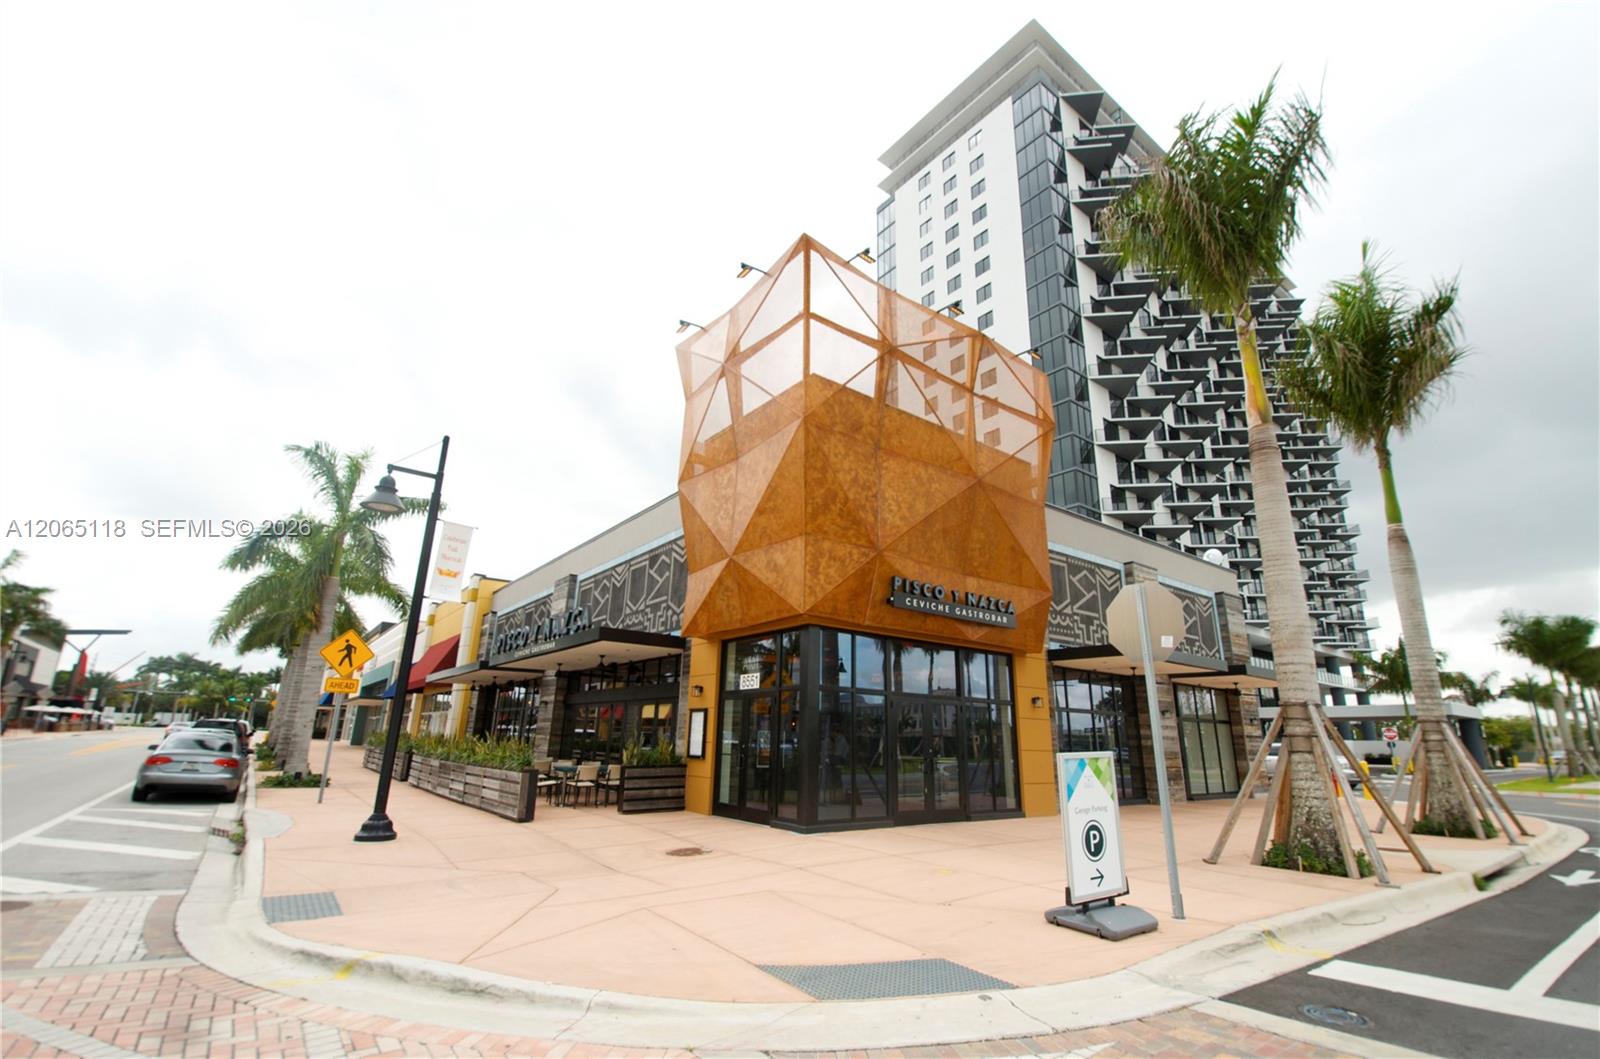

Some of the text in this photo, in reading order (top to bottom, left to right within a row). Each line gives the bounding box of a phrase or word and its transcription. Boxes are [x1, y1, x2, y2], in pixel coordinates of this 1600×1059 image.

[892, 576, 1016, 615] PISCO Y NAZCA
[905, 597, 1008, 623] CEVICHE GASTROBAR
[330, 681, 355, 689] AHEAD
[742, 675, 758, 688] 8551
[1089, 830, 1100, 852] P
